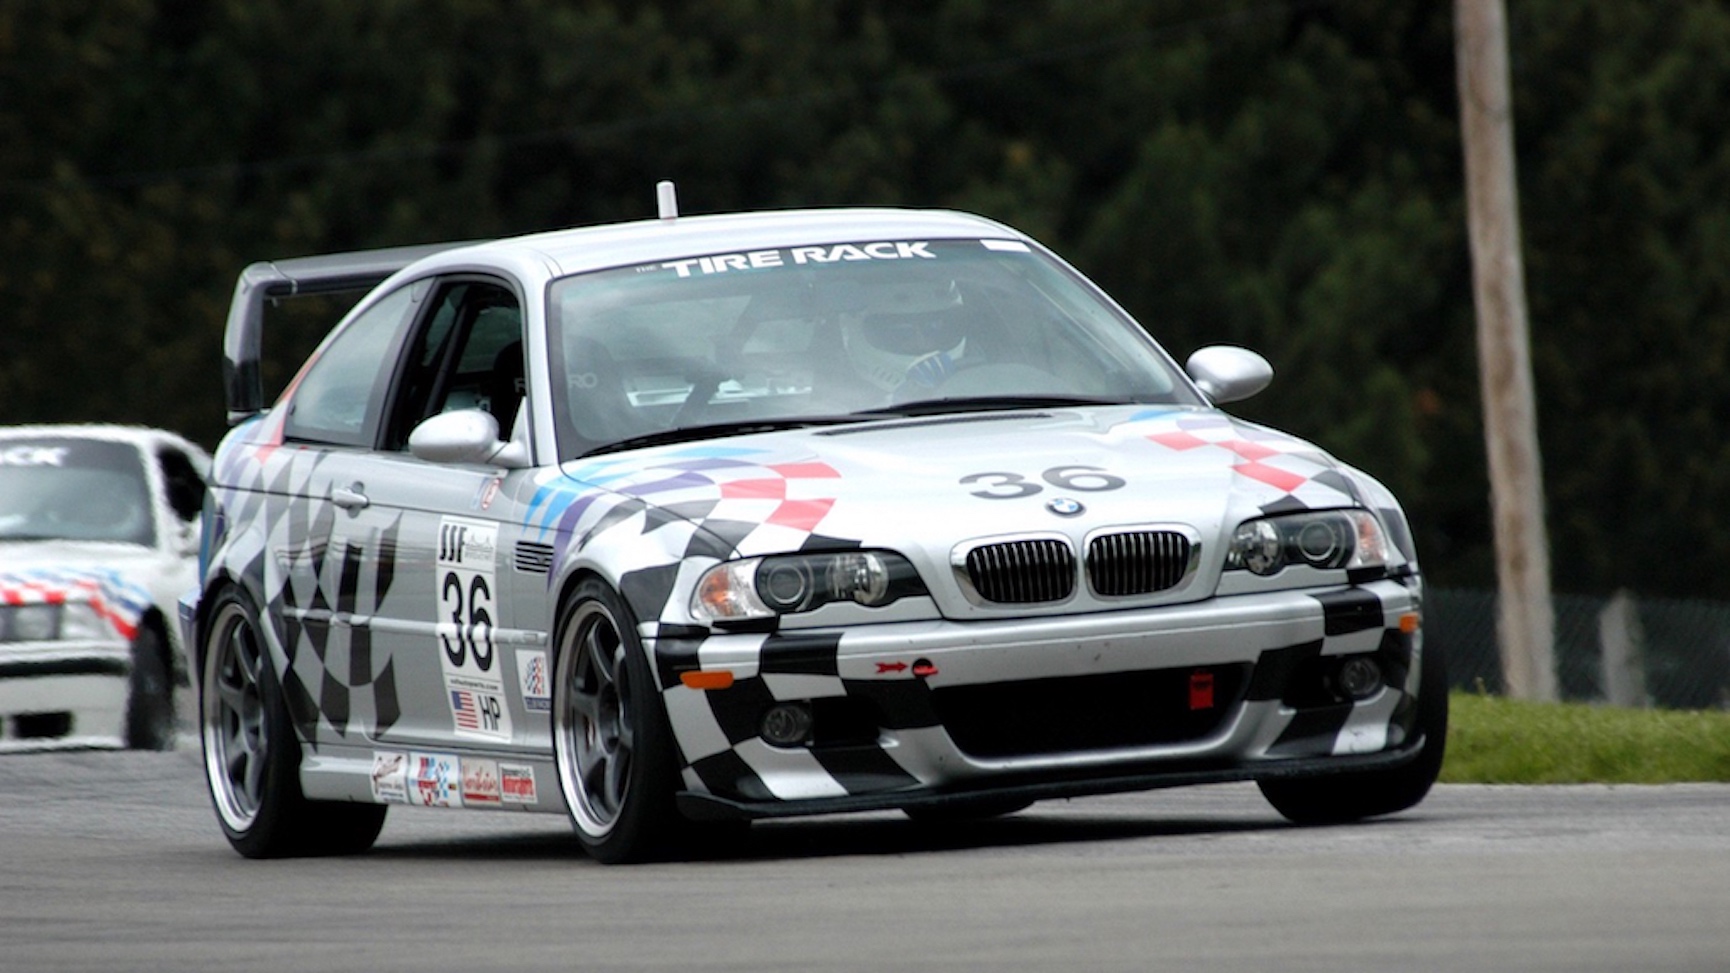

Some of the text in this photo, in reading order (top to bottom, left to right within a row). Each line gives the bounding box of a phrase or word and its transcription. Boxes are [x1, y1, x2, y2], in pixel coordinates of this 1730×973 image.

[661, 250, 784, 278] TIRE
[791, 241, 937, 265] RACK
[0, 446, 70, 467] CK
[959, 465, 1127, 500] 36
[439, 524, 468, 563] SSF
[440, 571, 494, 672] 36
[478, 695, 501, 731] HP
